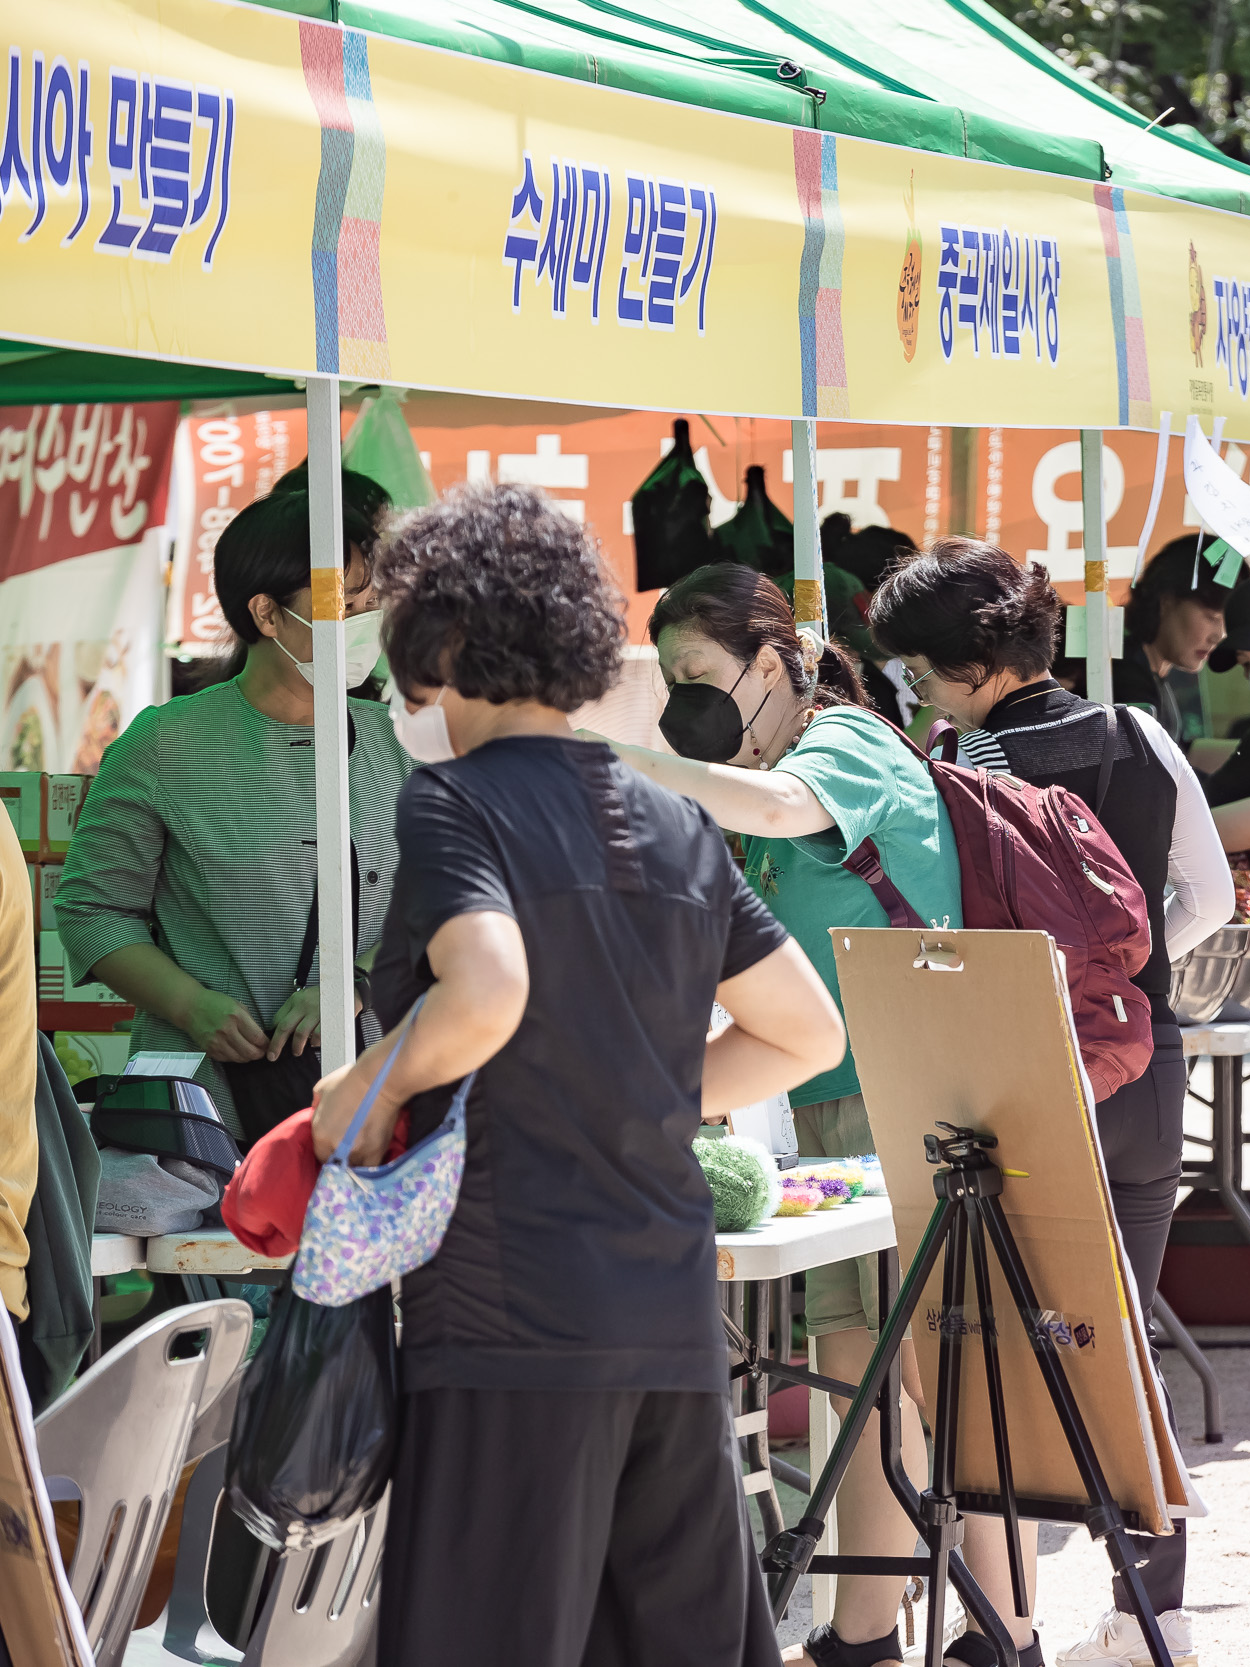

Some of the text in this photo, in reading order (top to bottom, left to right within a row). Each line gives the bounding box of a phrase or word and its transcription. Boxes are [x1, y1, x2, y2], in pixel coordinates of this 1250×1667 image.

[98, 72, 235, 268] 만들기
[505, 153, 609, 321] 수세미
[618, 171, 717, 335] 만들기
[938, 227, 1060, 364] 중곡제일시장
